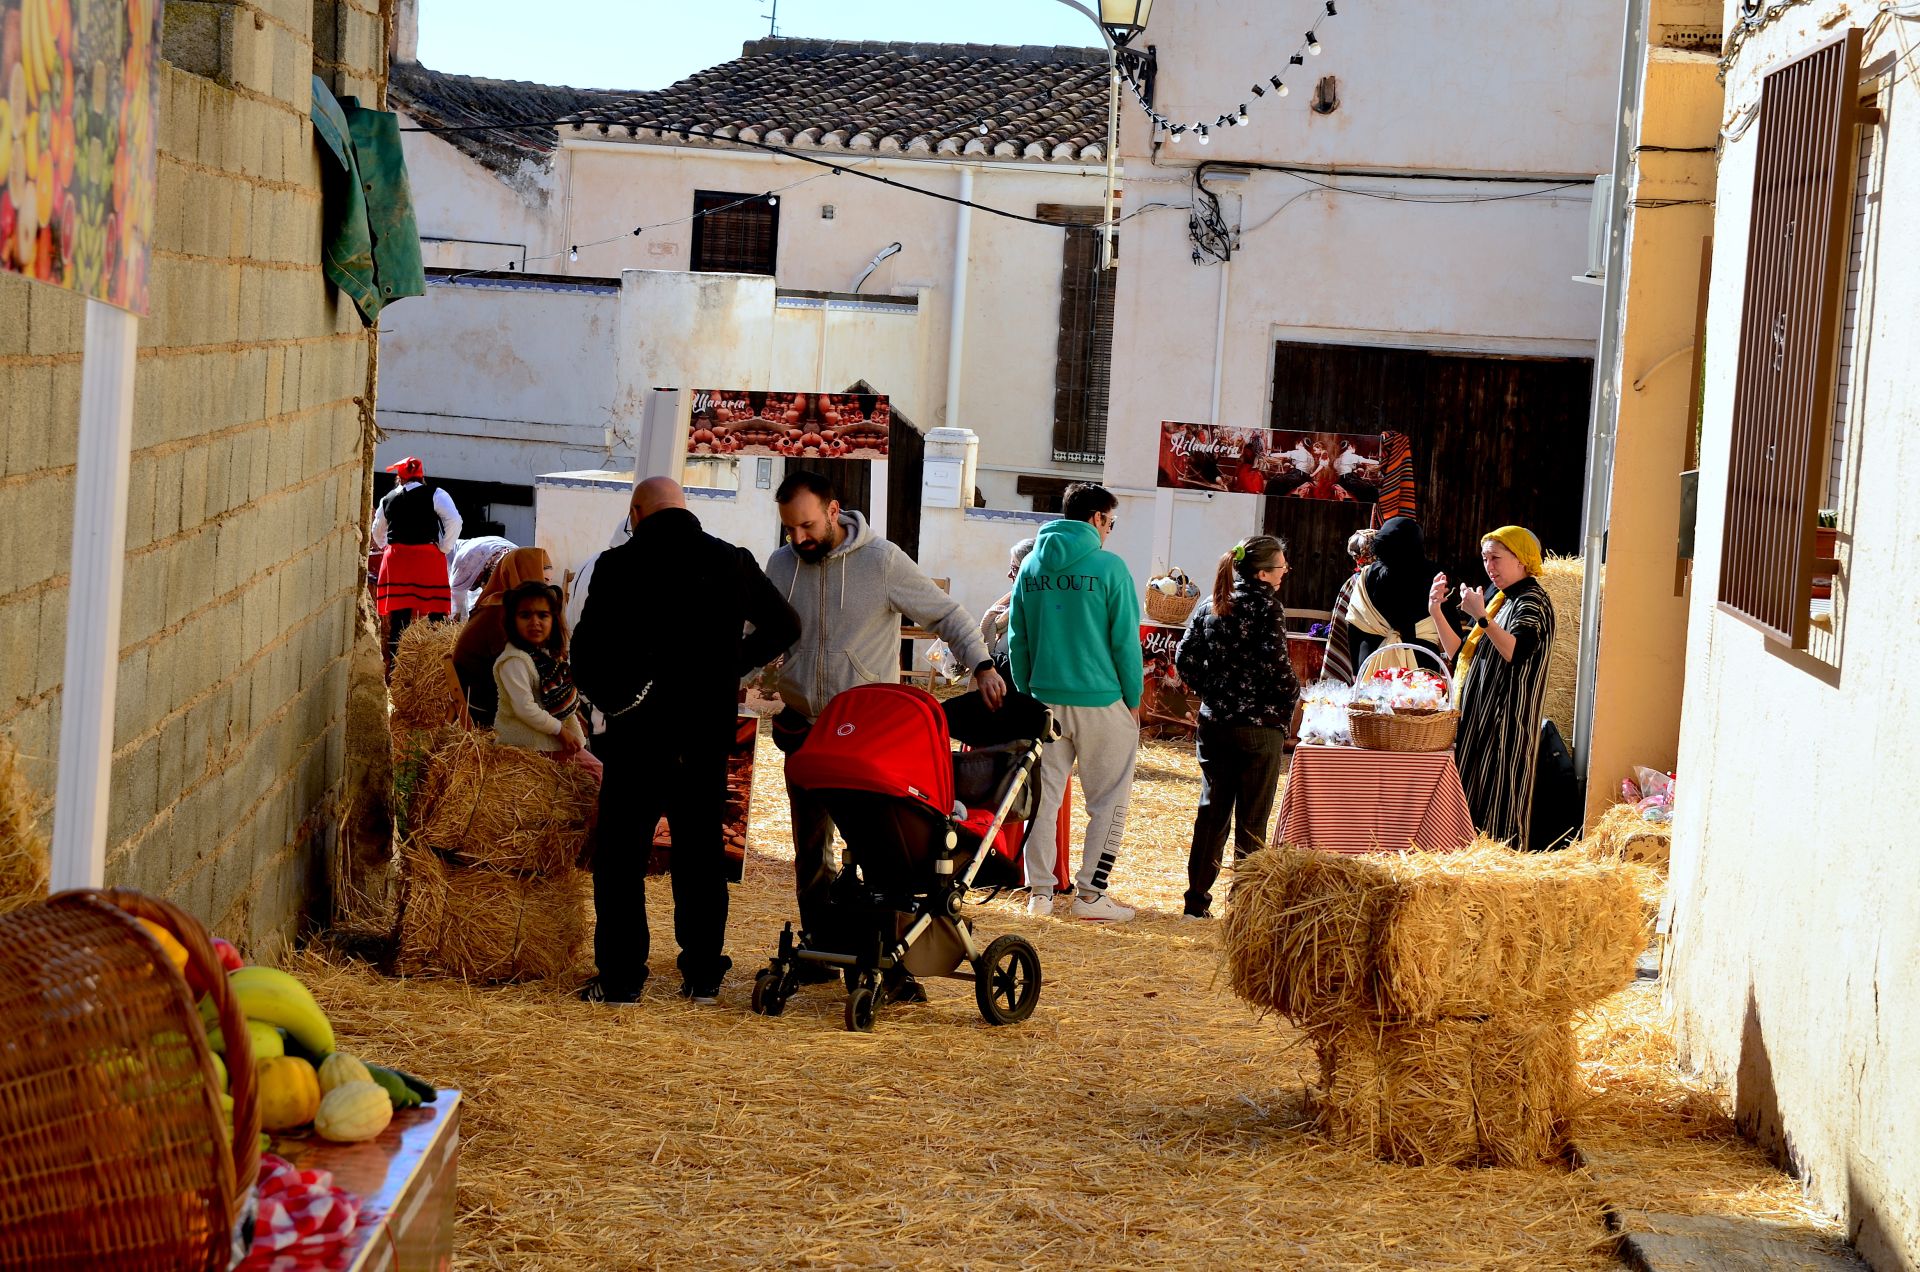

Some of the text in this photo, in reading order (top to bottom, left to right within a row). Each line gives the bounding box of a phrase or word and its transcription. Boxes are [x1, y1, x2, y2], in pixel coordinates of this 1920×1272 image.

[1024, 574, 1099, 593] FAR OUT
[1145, 632, 1178, 654] Hila
